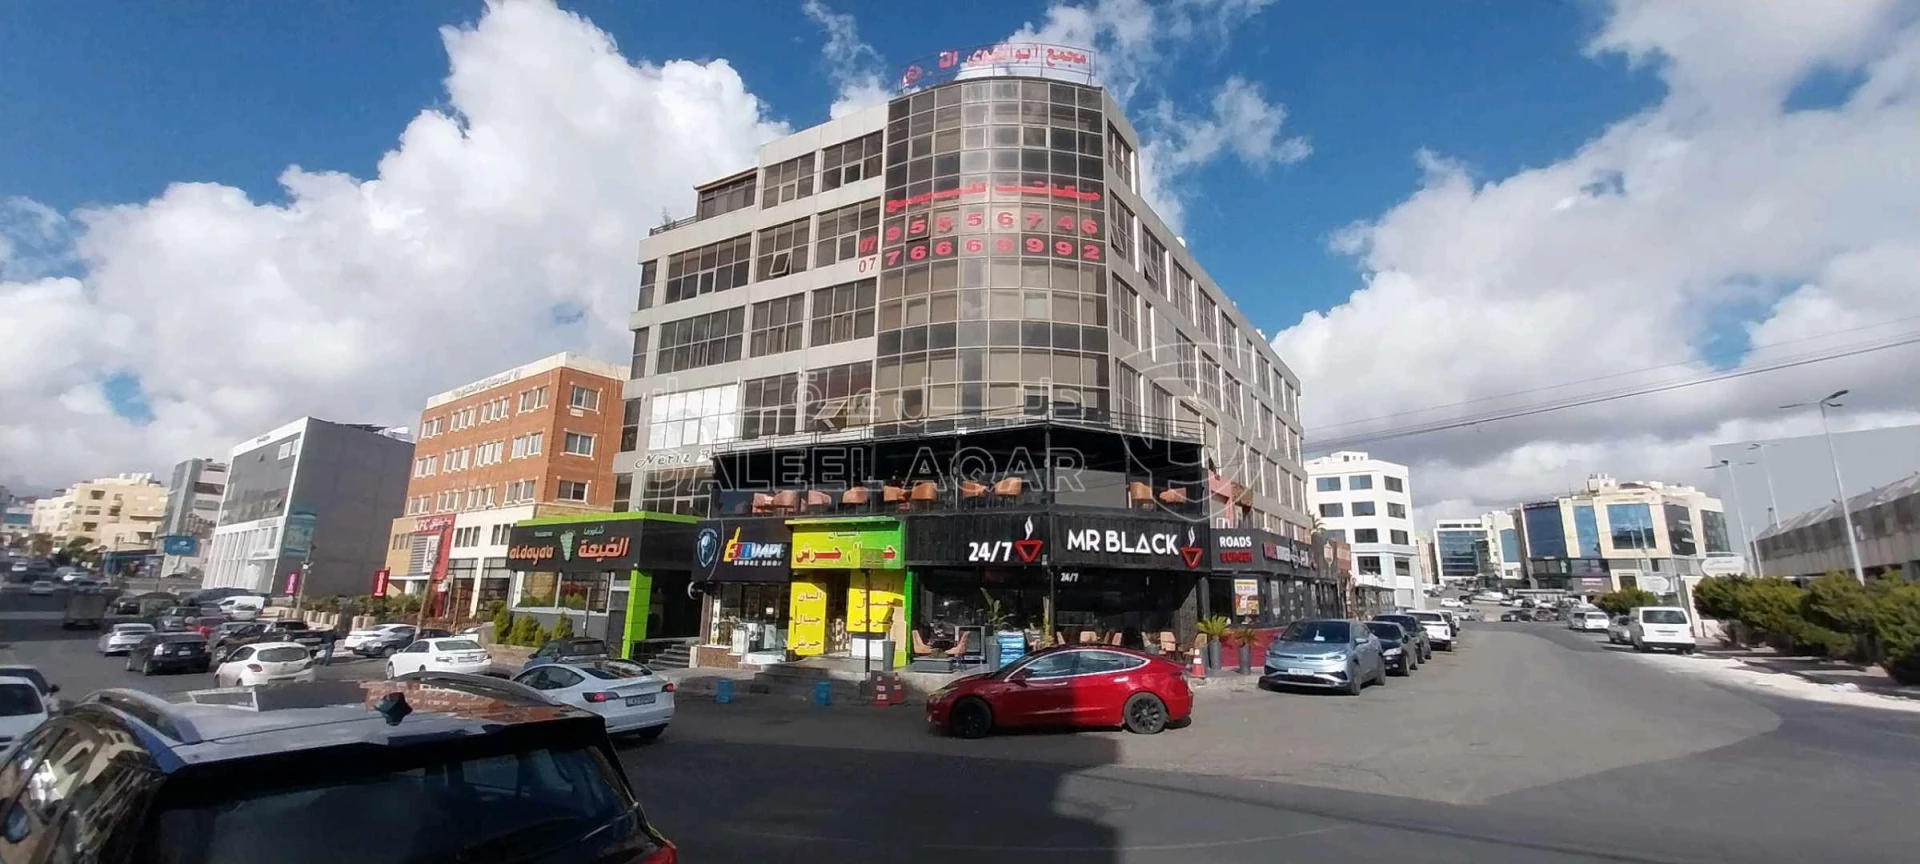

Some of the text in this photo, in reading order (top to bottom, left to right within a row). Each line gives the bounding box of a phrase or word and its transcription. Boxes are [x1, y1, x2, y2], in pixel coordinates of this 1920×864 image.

[858, 257, 877, 274] 07
[578, 536, 631, 562] الضيعة
[968, 540, 1013, 562] 24/7
[1067, 529, 1179, 556] MR BLACK
[1219, 536, 1252, 548] ROADS
[1060, 572, 1079, 582] 24/7
